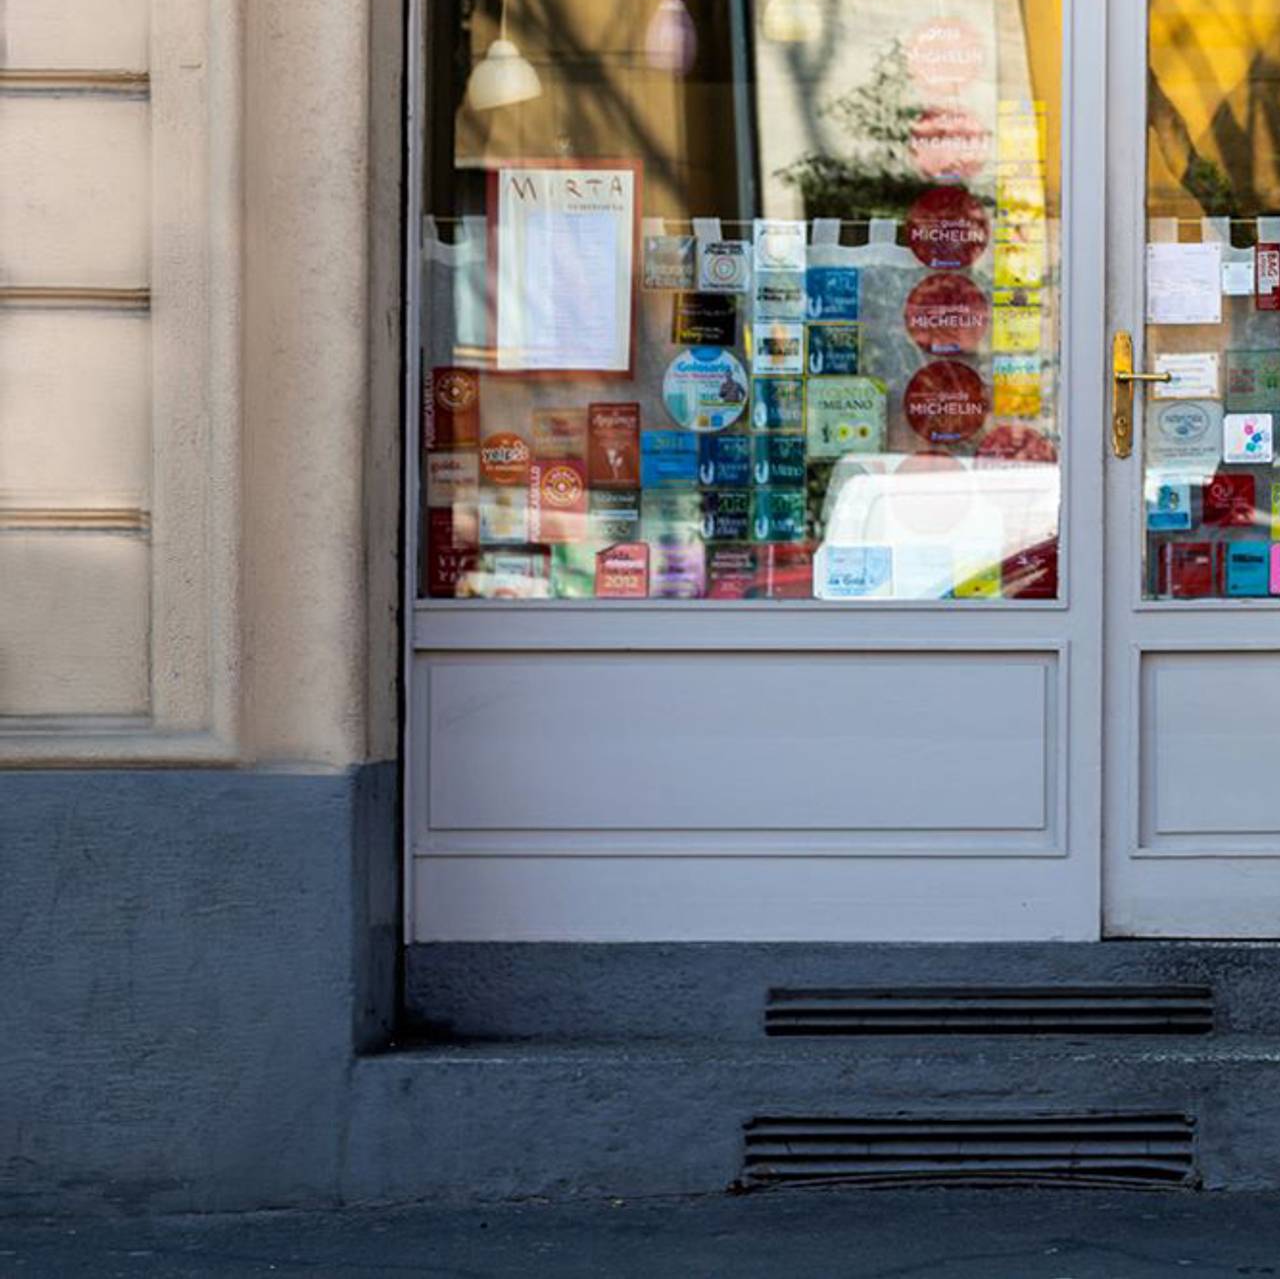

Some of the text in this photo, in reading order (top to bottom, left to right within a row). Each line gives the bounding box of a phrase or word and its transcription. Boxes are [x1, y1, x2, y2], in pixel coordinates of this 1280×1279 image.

[911, 228, 984, 243] MICHELIN
[911, 314, 983, 329] MICHELIN
[910, 401, 983, 416] MICHELIN
